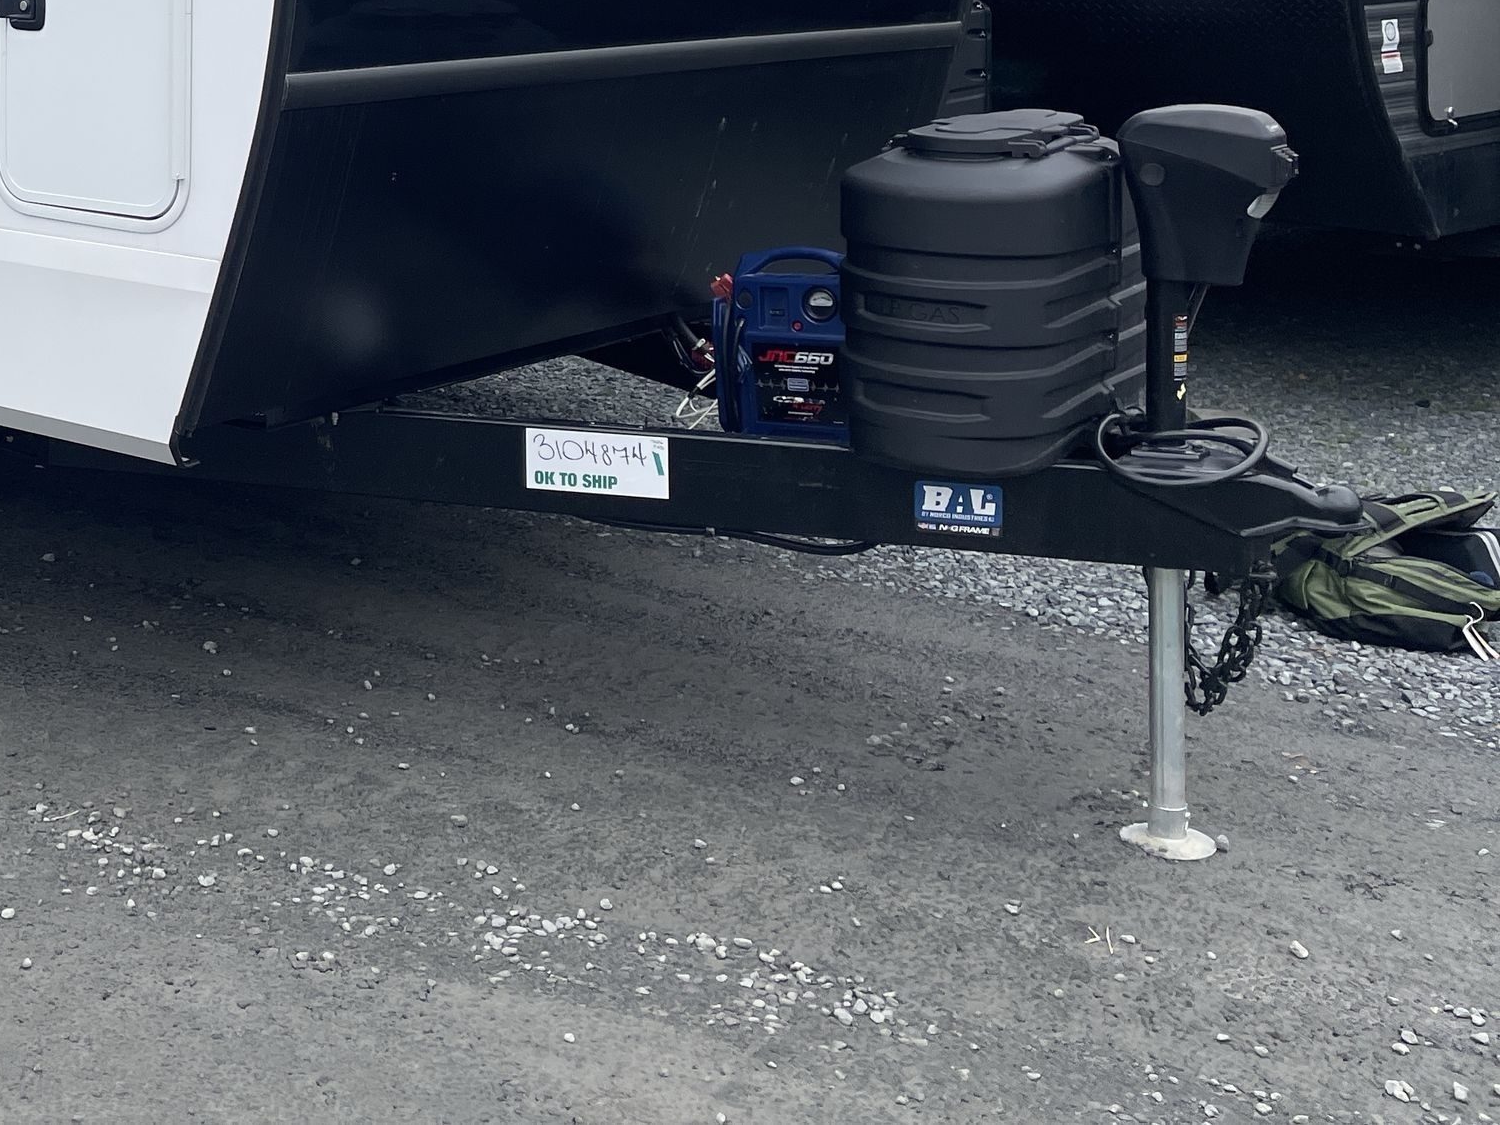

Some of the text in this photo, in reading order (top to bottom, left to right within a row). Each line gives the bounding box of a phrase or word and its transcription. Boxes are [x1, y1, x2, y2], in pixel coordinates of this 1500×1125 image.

[909, 303, 960, 325] GAS
[534, 470, 618, 489] OK TO SHIP
[929, 511, 951, 519] NORCO
